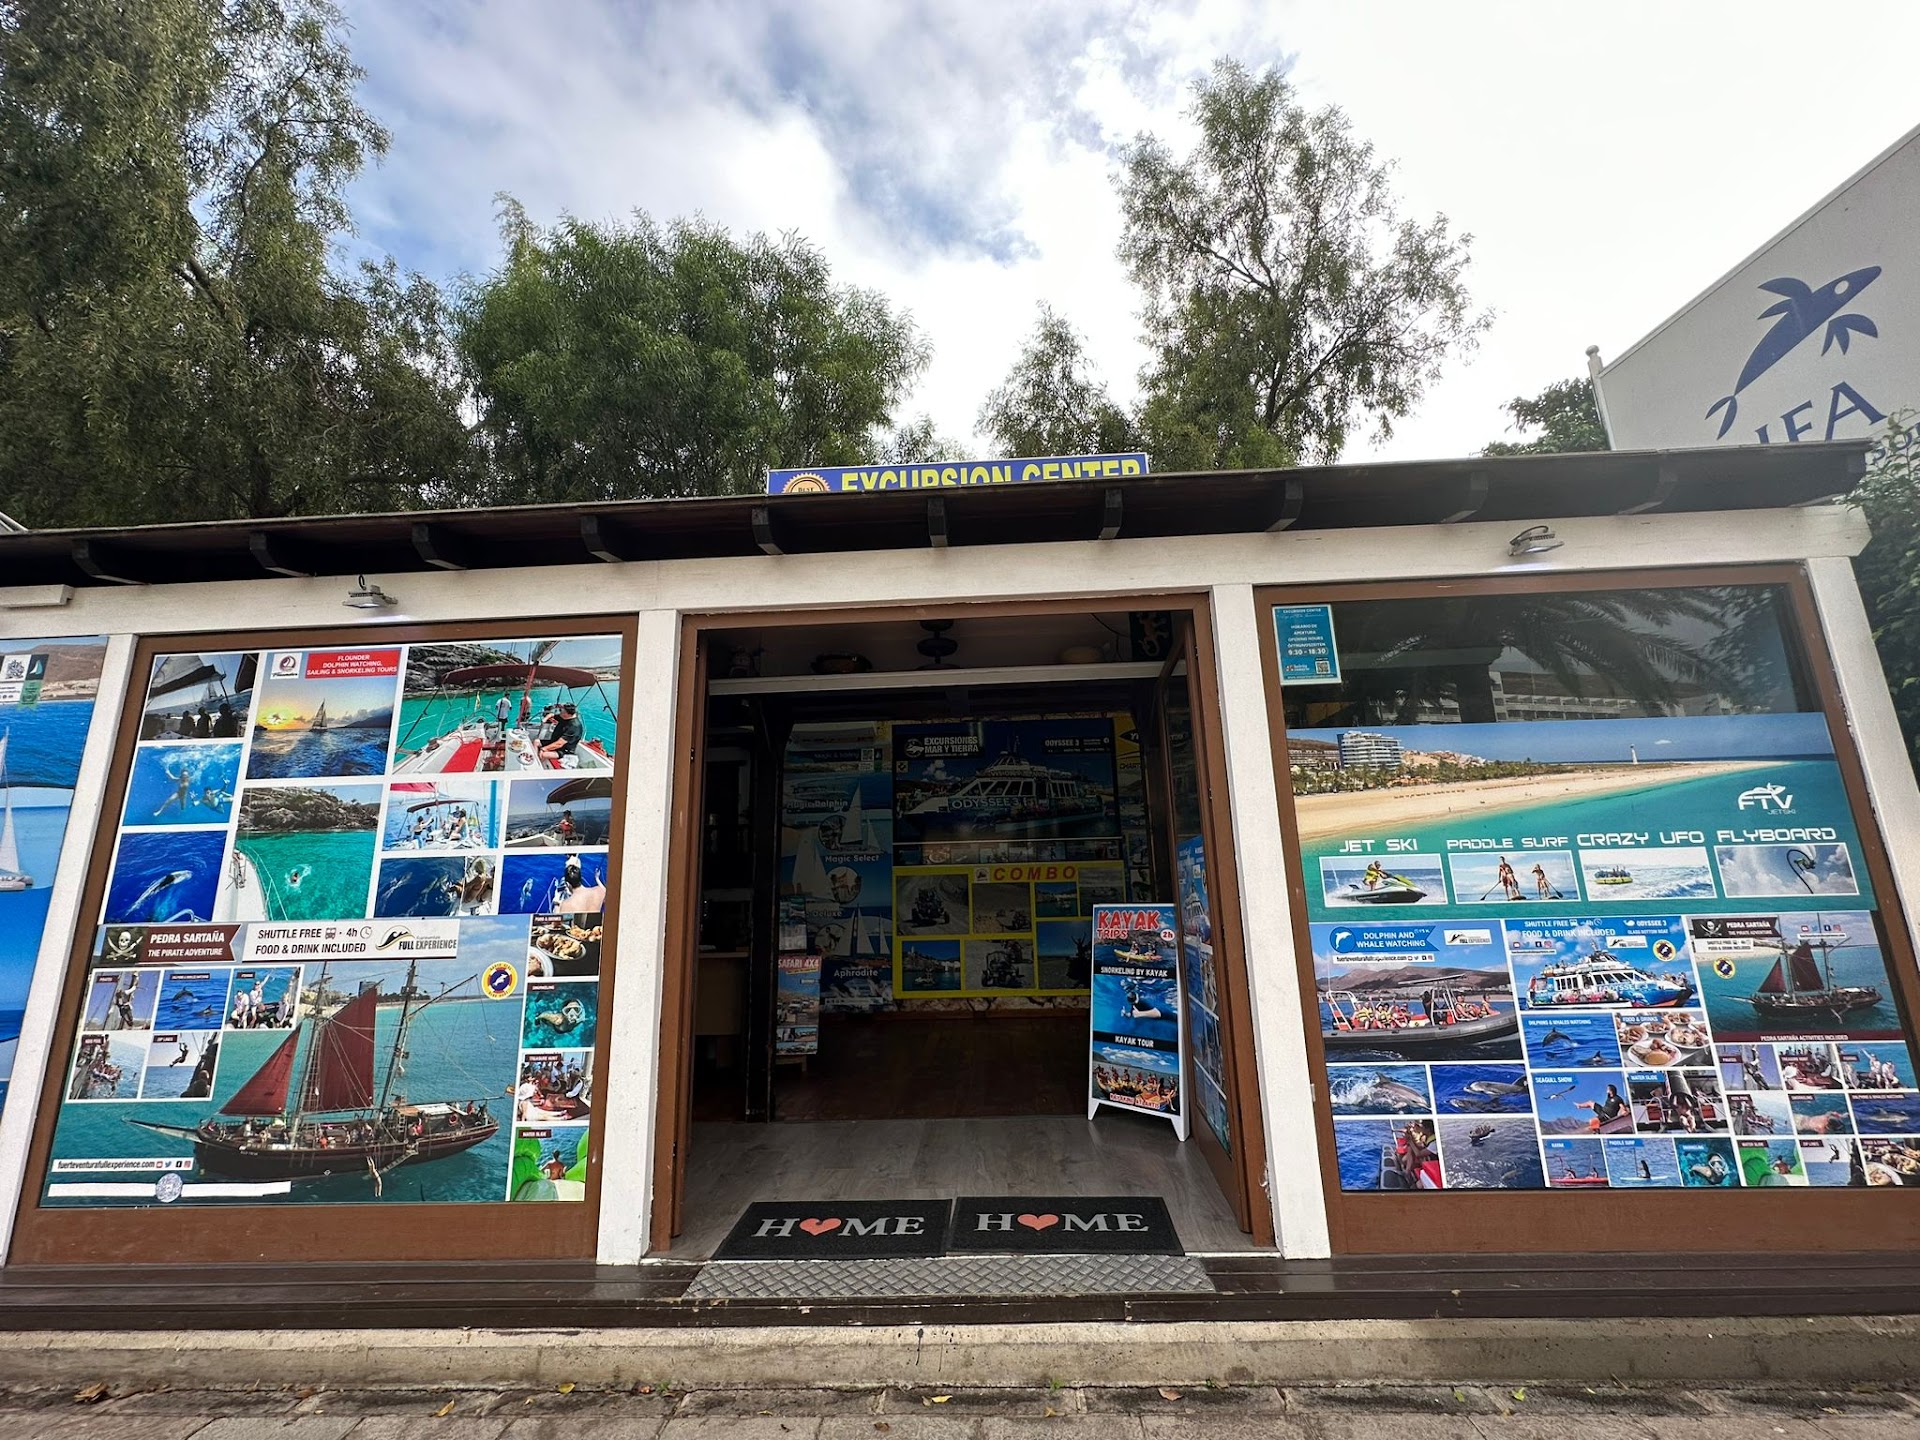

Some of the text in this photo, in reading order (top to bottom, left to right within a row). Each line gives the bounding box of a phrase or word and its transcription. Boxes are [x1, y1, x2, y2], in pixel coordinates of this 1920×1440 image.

[322, 661, 349, 669] DOLPHIN
[337, 667, 376, 675] SNORKELING
[923, 736, 978, 746] EXCURSIONES
[924, 744, 979, 753] MAR Y TIERRA
[951, 797, 1011, 809] ODYSSEE
[1339, 827, 1837, 853] JET SKI PADDLE SURF CRAZY UFO FLYBOARD
[825, 854, 880, 864] Magic Select
[993, 865, 1076, 881] COMBO
[1097, 909, 1161, 931] KAYAK
[1524, 920, 1552, 928] SHUTTLE
[150, 931, 225, 944] PEDRA SARTAÑA
[257, 927, 358, 939] SHUTTLE FREE 4h
[1096, 928, 1174, 940] TRIPS 2h
[1363, 932, 1397, 940] DOLPHIN
[1398, 931, 1415, 939] AND
[1522, 930, 1542, 938] FOOD
[1552, 929, 1577, 937] DRINK
[1578, 928, 1616, 936] INCLUDED
[255, 942, 367, 955] FOOD & DRINK INCLUDED
[398, 939, 457, 950] FULL EXPERIENCE
[1356, 939, 1426, 948] WHALE WATCHING
[148, 948, 223, 958] THE PIRATE ADVENTURE
[778, 959, 803, 969] SAFARI
[833, 967, 879, 977] Aphrodite
[1100, 966, 1168, 978] SNORKELING BY KAYAK
[1115, 1035, 1154, 1048] KAYAK TOUR
[57, 1160, 155, 1170] fuerteventurafullexperience.com
